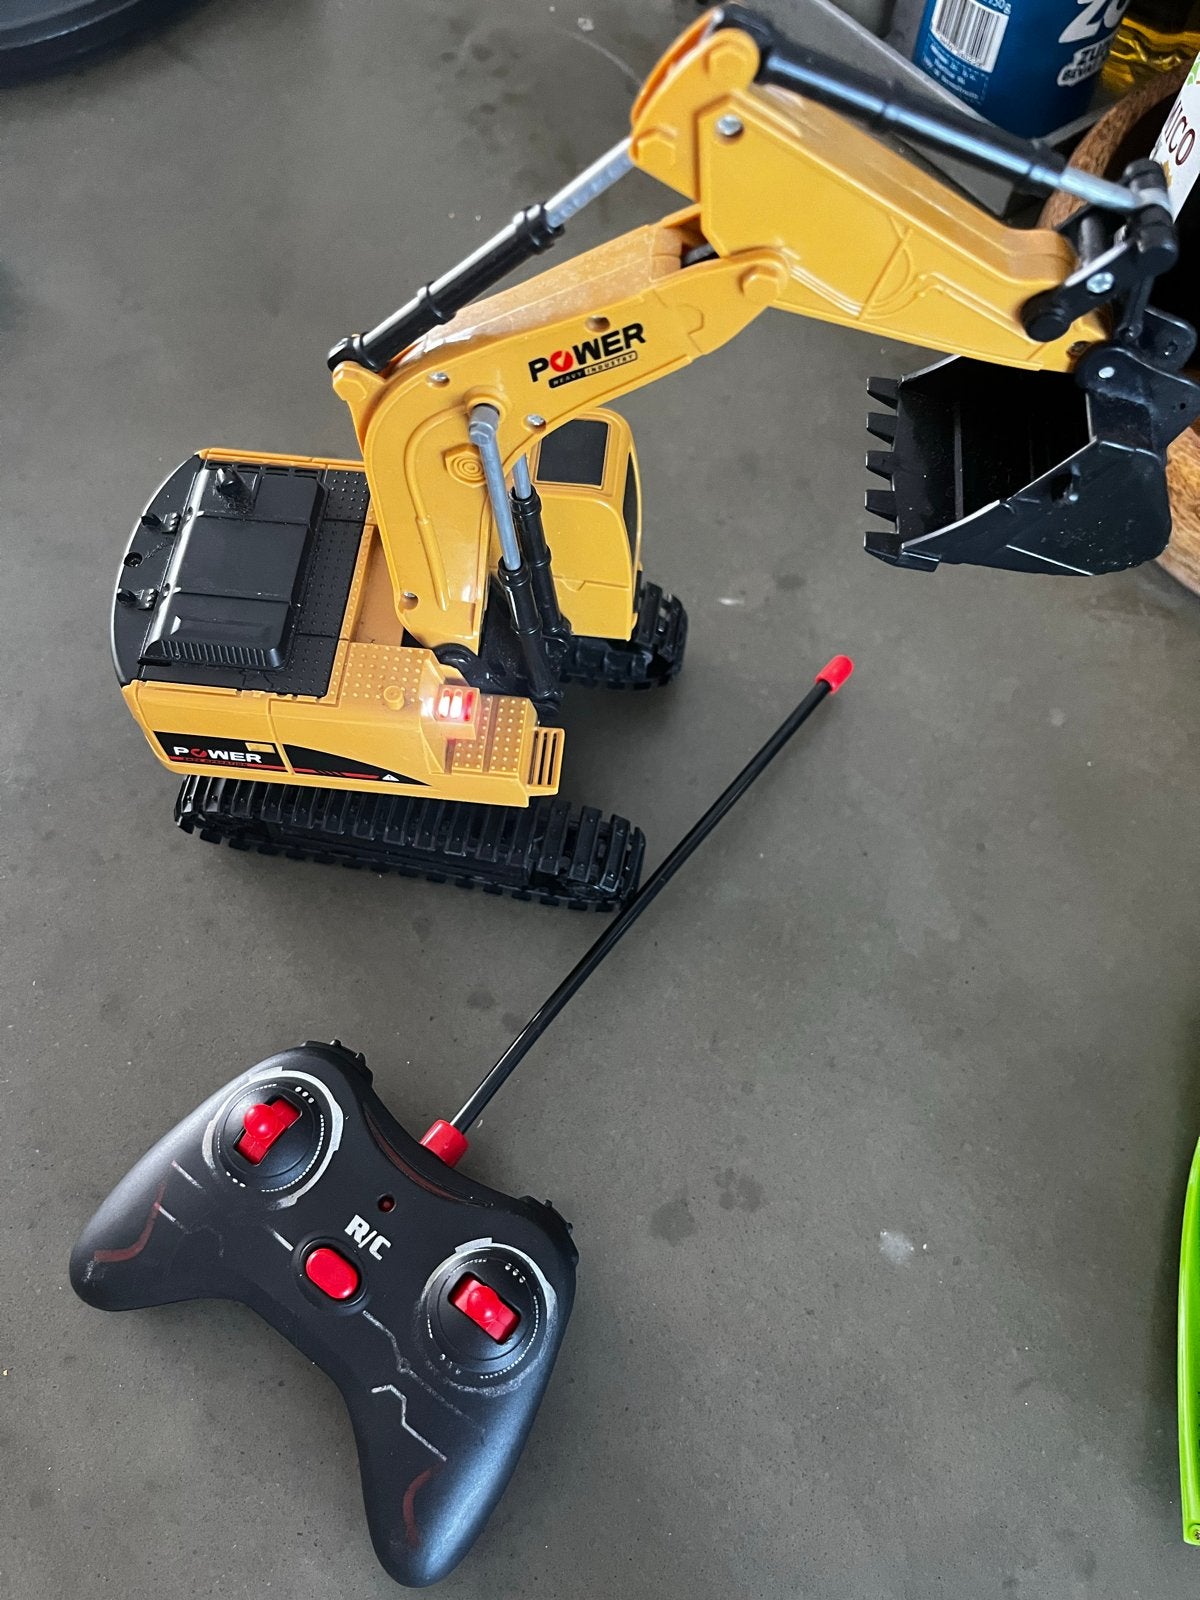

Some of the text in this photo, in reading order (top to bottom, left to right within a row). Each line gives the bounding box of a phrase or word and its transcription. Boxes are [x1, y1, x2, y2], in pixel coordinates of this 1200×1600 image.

[528, 322, 646, 383] POWER
[552, 354, 634, 387] HEAVY INDUSTRY
[173, 746, 263, 763] POWER
[344, 1214, 392, 1261] R/C
